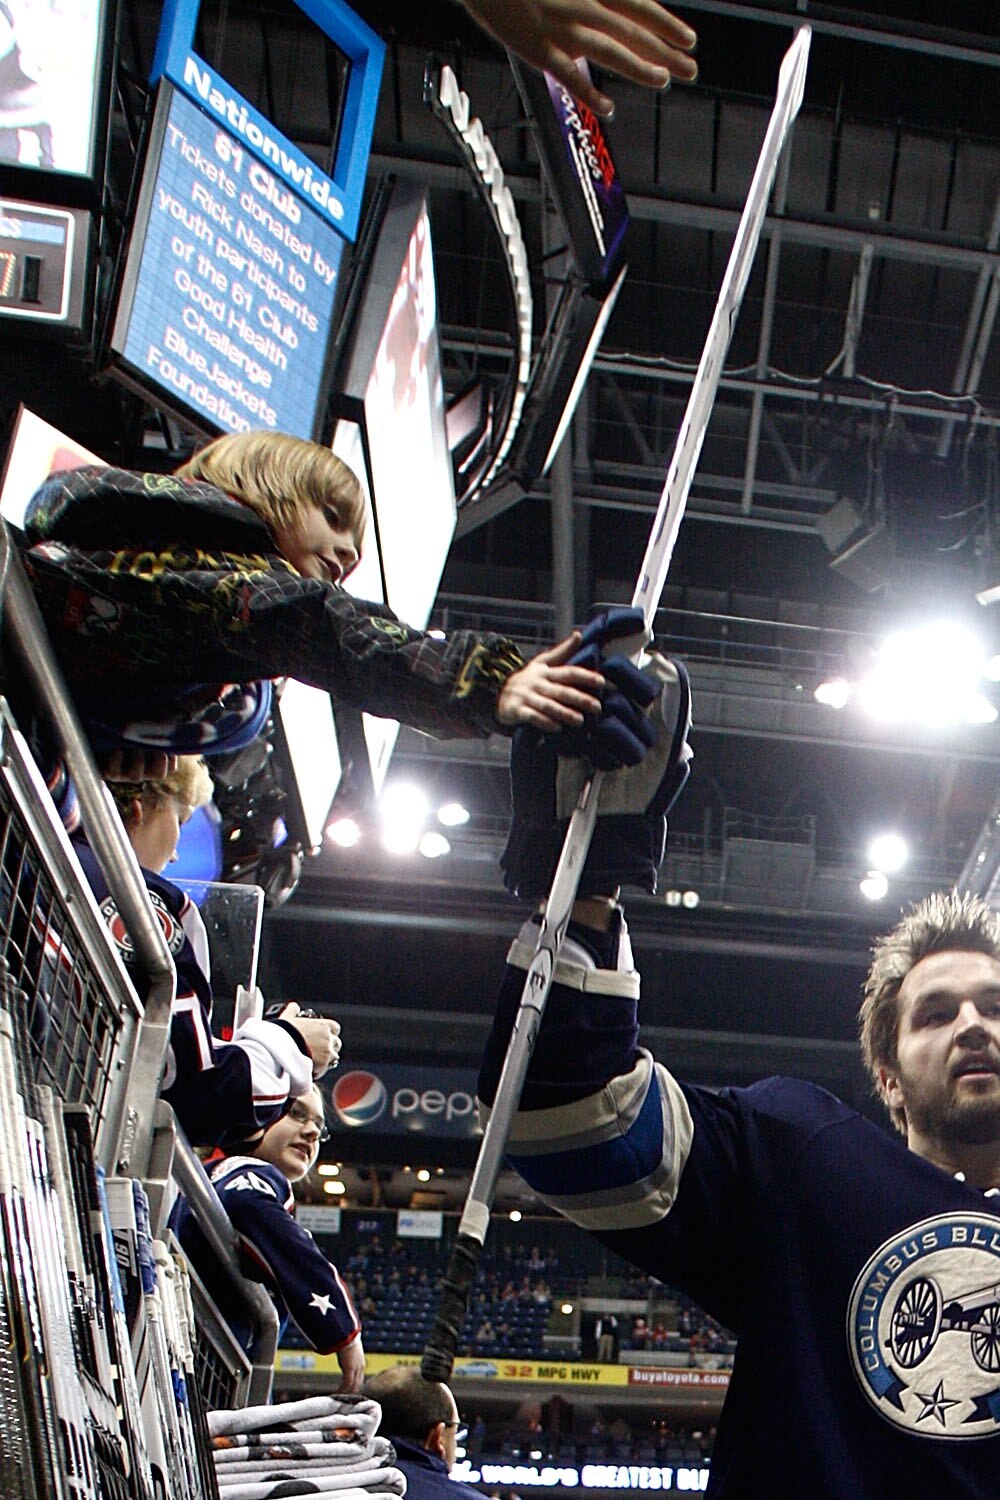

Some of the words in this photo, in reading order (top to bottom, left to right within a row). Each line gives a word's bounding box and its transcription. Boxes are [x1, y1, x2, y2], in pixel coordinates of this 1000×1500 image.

[184, 56, 344, 221] Nationwide
[214, 130, 243, 173] 61
[248, 163, 301, 224] Club
[168, 122, 236, 198] Tickets
[240, 193, 311, 264] donated
[313, 252, 336, 285] by
[192, 182, 234, 231] Rick
[236, 219, 284, 274] Nash
[288, 264, 305, 292] to
[159, 188, 213, 247] youth
[215, 236, 318, 332] participants
[171, 237, 195, 262] of
[198, 254, 228, 291] the
[231, 281, 252, 312] 61
[258, 304, 298, 349] Club
[174, 268, 225, 322] Good
[228, 309, 287, 370] Health
[183, 306, 272, 388] Challenge
[392, 1088, 479, 1121] pep
[859, 1231, 939, 1372] COLUMBUS
[504, 1364, 533, 1378] 32
[538, 1367, 567, 1380] MPG
[572, 1367, 602, 1381] HWY
[633, 1370, 729, 1386] buyatoyota.com
[582, 1464, 673, 1490] GREATEST
